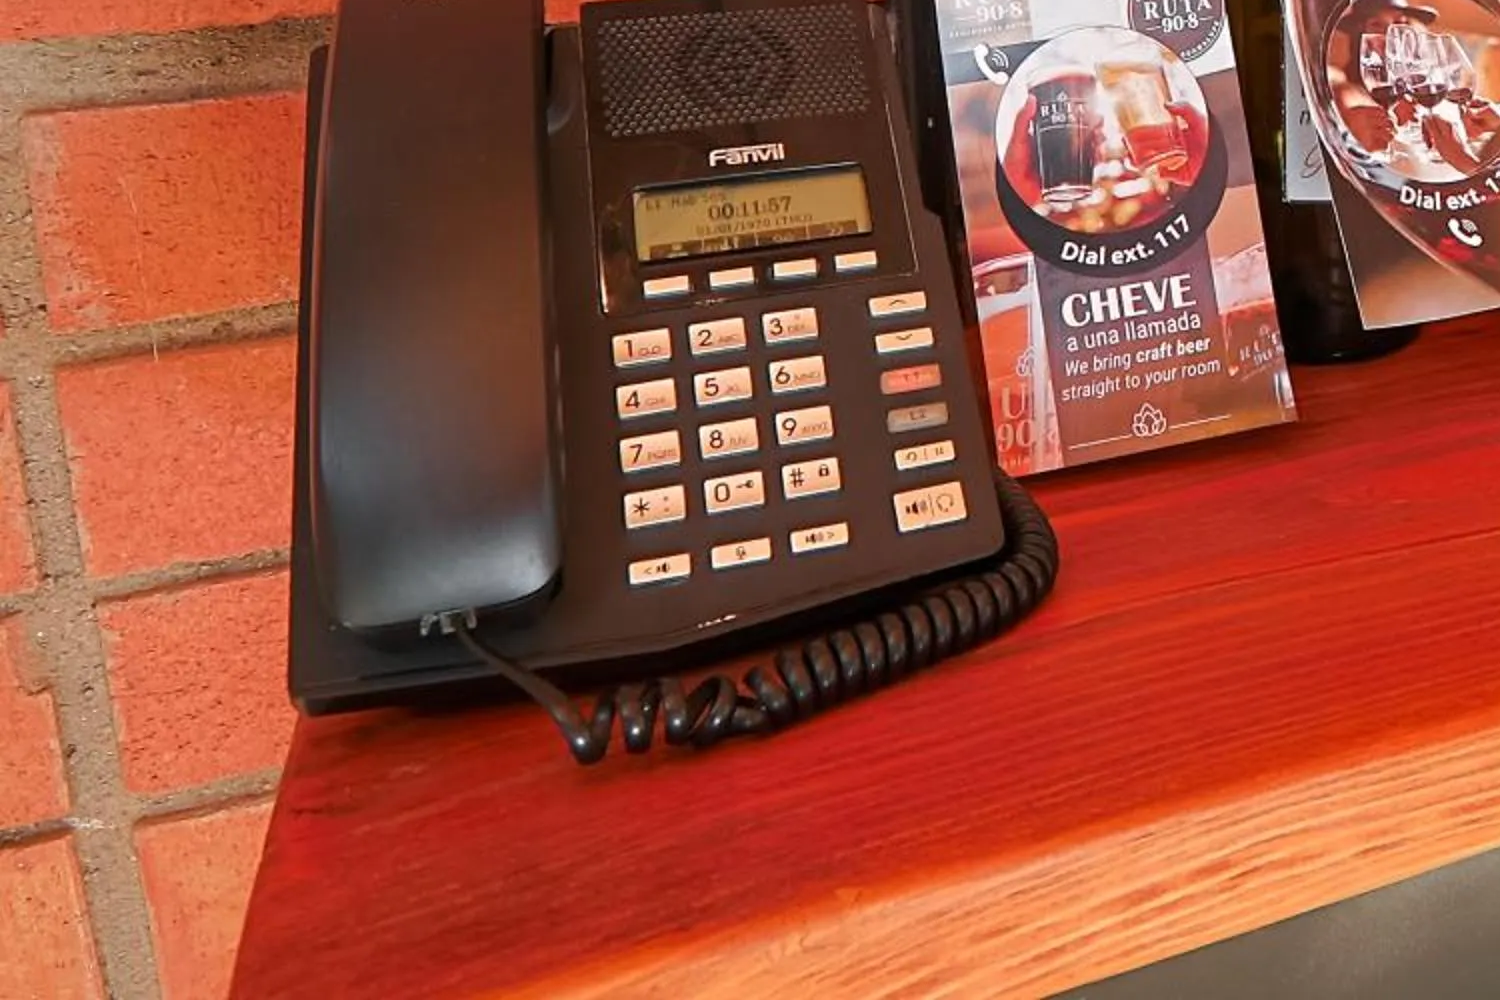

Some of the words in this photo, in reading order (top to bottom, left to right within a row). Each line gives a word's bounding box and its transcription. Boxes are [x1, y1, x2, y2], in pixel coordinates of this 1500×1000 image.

[708, 143, 786, 168] Fanvil
[707, 195, 793, 222] 00:11:57
[1398, 185, 1442, 211] Dial
[1445, 187, 1487, 211] ext.
[1060, 240, 1107, 266] Dial
[1110, 241, 1155, 265] ext.
[1153, 213, 1190, 249] 117
[1061, 272, 1197, 328] CHEVE
[769, 317, 784, 336] 3
[1067, 335, 1079, 352] a
[1084, 328, 1120, 349] una
[1124, 310, 1202, 341] llamada
[623, 339, 634, 358] 1
[697, 329, 713, 347] 2
[1065, 359, 1089, 377] We
[1093, 352, 1131, 371] bring
[1135, 341, 1173, 363] craft
[1176, 336, 1212, 355] beer
[775, 366, 791, 385] 6
[1061, 376, 1122, 401] straight
[1125, 375, 1141, 389] to
[1145, 366, 1178, 390] your
[1181, 358, 1222, 379] room
[704, 377, 719, 397] 5
[625, 390, 640, 409] 4
[781, 417, 797, 437] 9
[709, 429, 724, 449] 8
[629, 443, 643, 465] 7
[789, 467, 804, 488] #
[714, 482, 731, 504] 0
